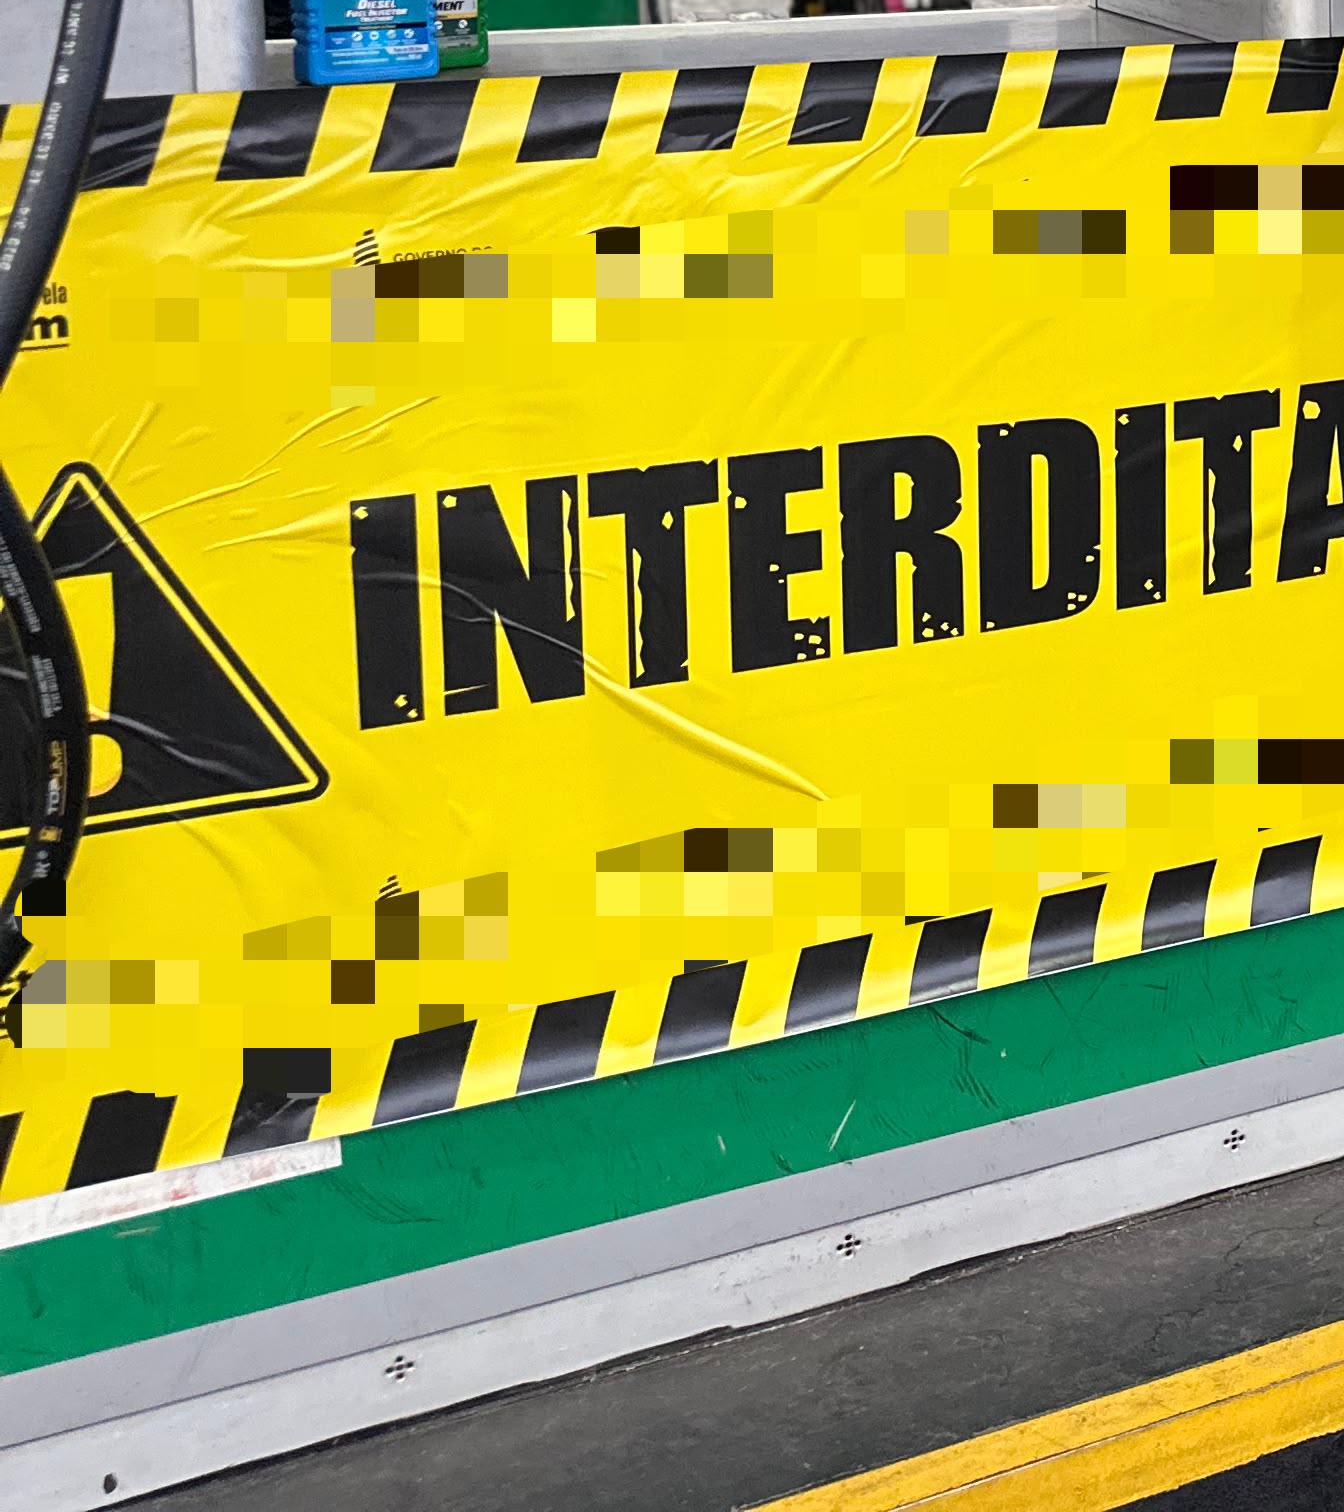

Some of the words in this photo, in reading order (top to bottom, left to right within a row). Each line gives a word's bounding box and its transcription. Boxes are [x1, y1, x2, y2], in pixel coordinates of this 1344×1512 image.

[357, 0, 396, 10] DIESEL
[346, 9, 368, 18] FUEL
[368, 8, 408, 17] INJECTOR
